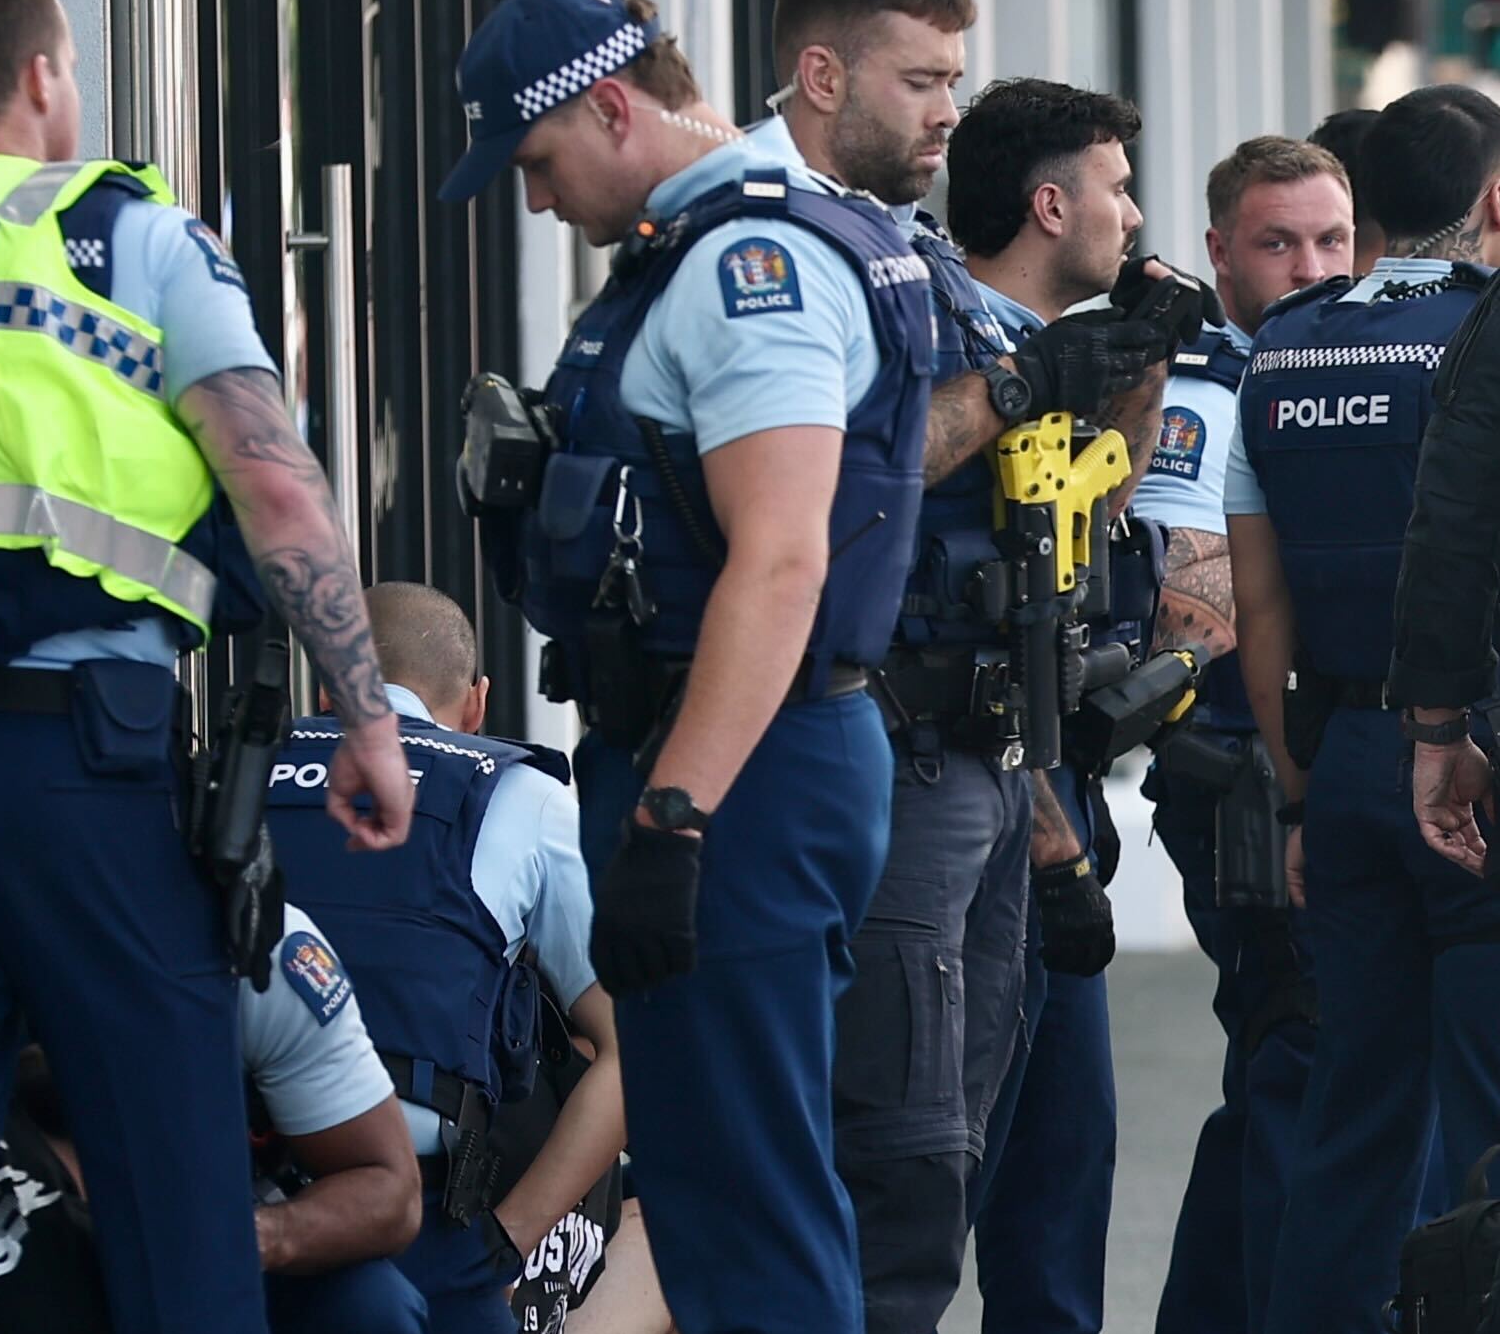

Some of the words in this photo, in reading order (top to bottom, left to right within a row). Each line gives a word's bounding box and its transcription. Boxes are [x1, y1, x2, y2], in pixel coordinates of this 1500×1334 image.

[736, 294, 793, 311] POLICE
[1277, 394, 1391, 430] POLICE
[1149, 457, 1194, 475] OLICE
